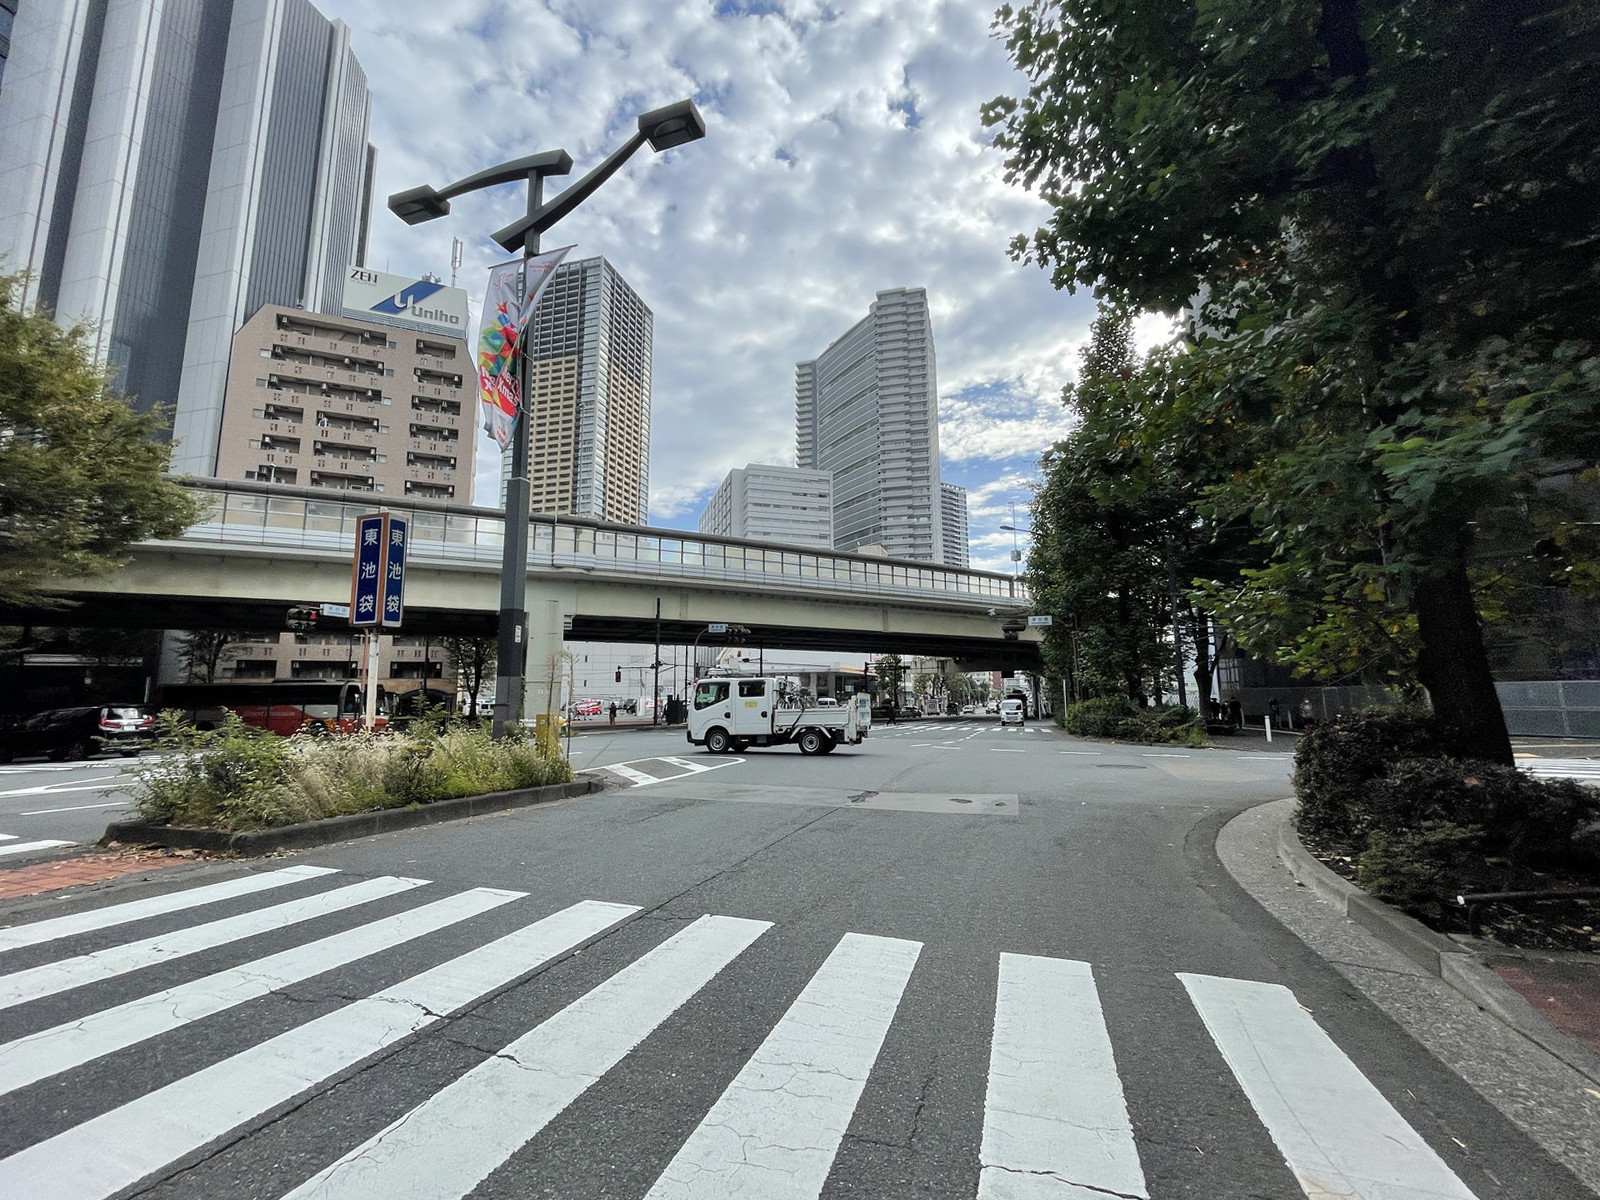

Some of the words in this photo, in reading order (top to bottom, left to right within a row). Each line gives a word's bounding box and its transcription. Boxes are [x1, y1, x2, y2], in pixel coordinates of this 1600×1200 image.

[350, 268, 378, 283] ZEN
[358, 528, 378, 614] 東池袋
[386, 528, 404, 614] 東池袋
